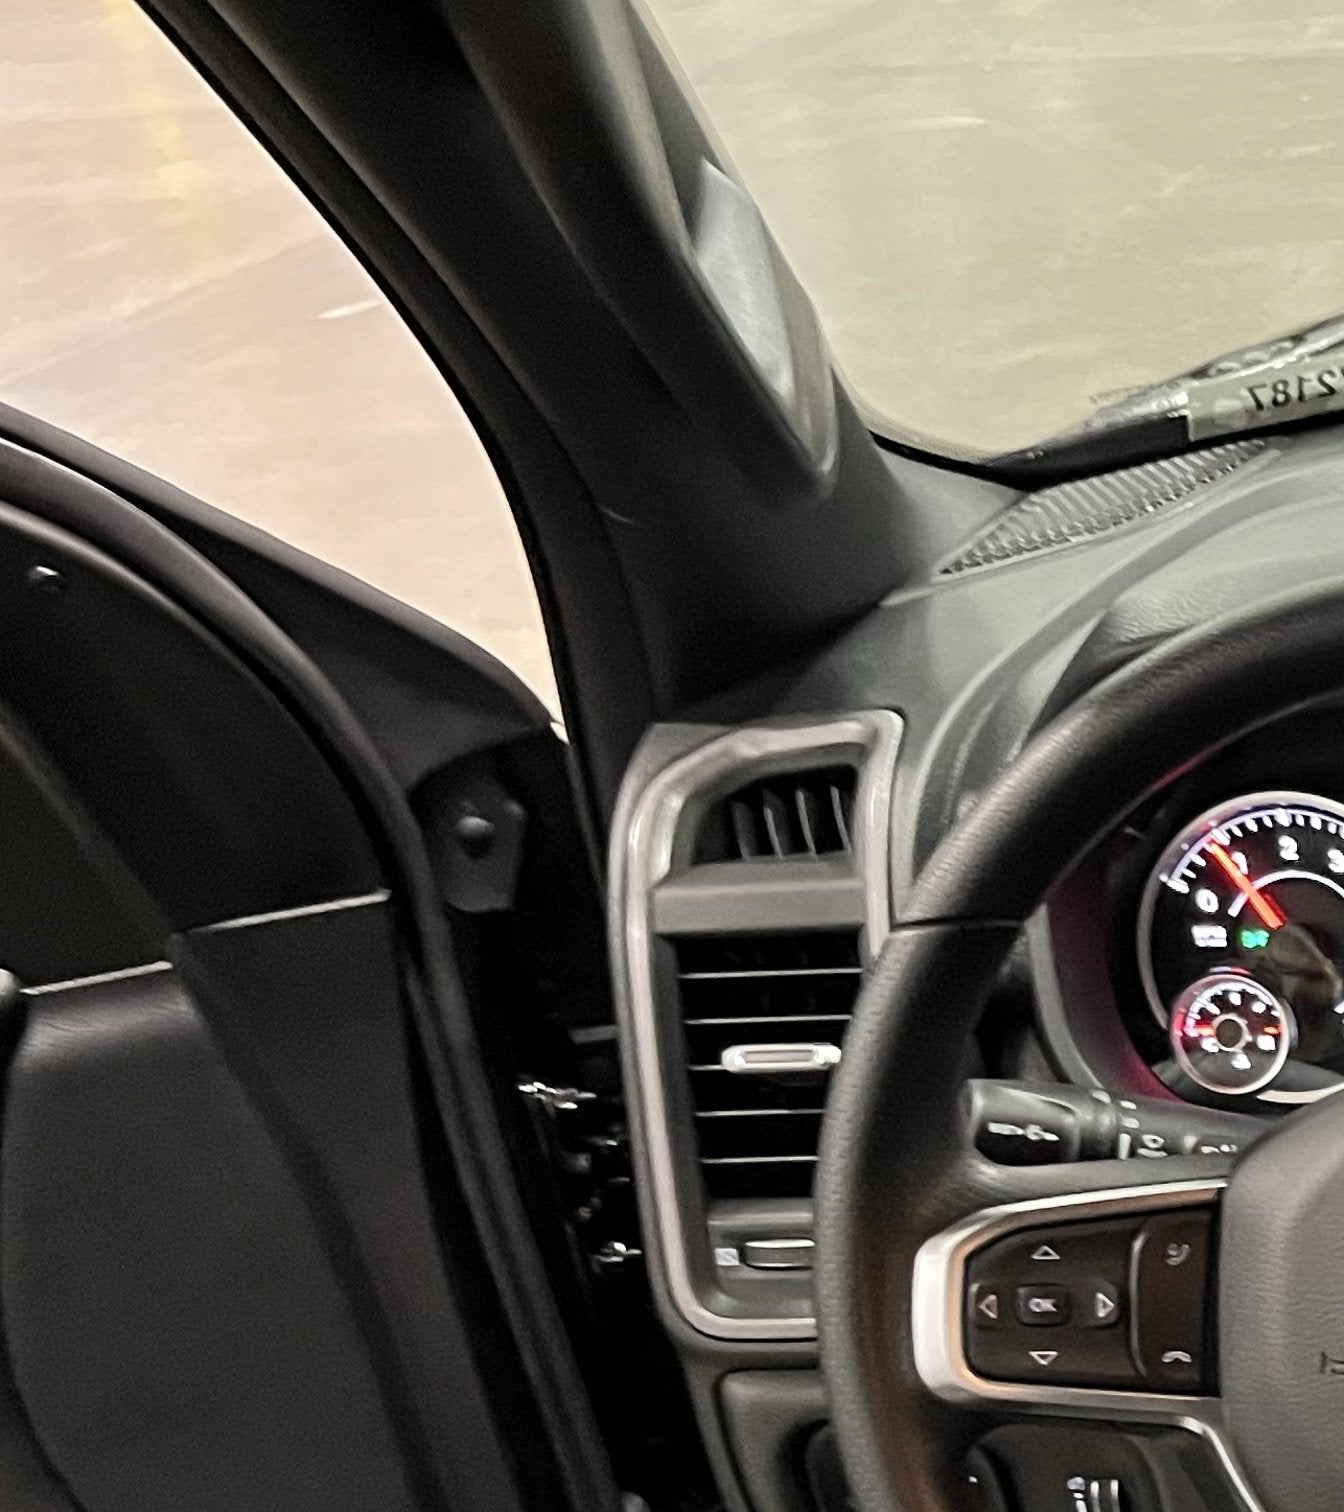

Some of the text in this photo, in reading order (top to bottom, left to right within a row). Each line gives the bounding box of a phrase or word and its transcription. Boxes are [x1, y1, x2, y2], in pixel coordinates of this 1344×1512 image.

[1278, 835, 1299, 861] 2
[1195, 888, 1220, 914] 0
[1028, 1298, 1058, 1313] OK
